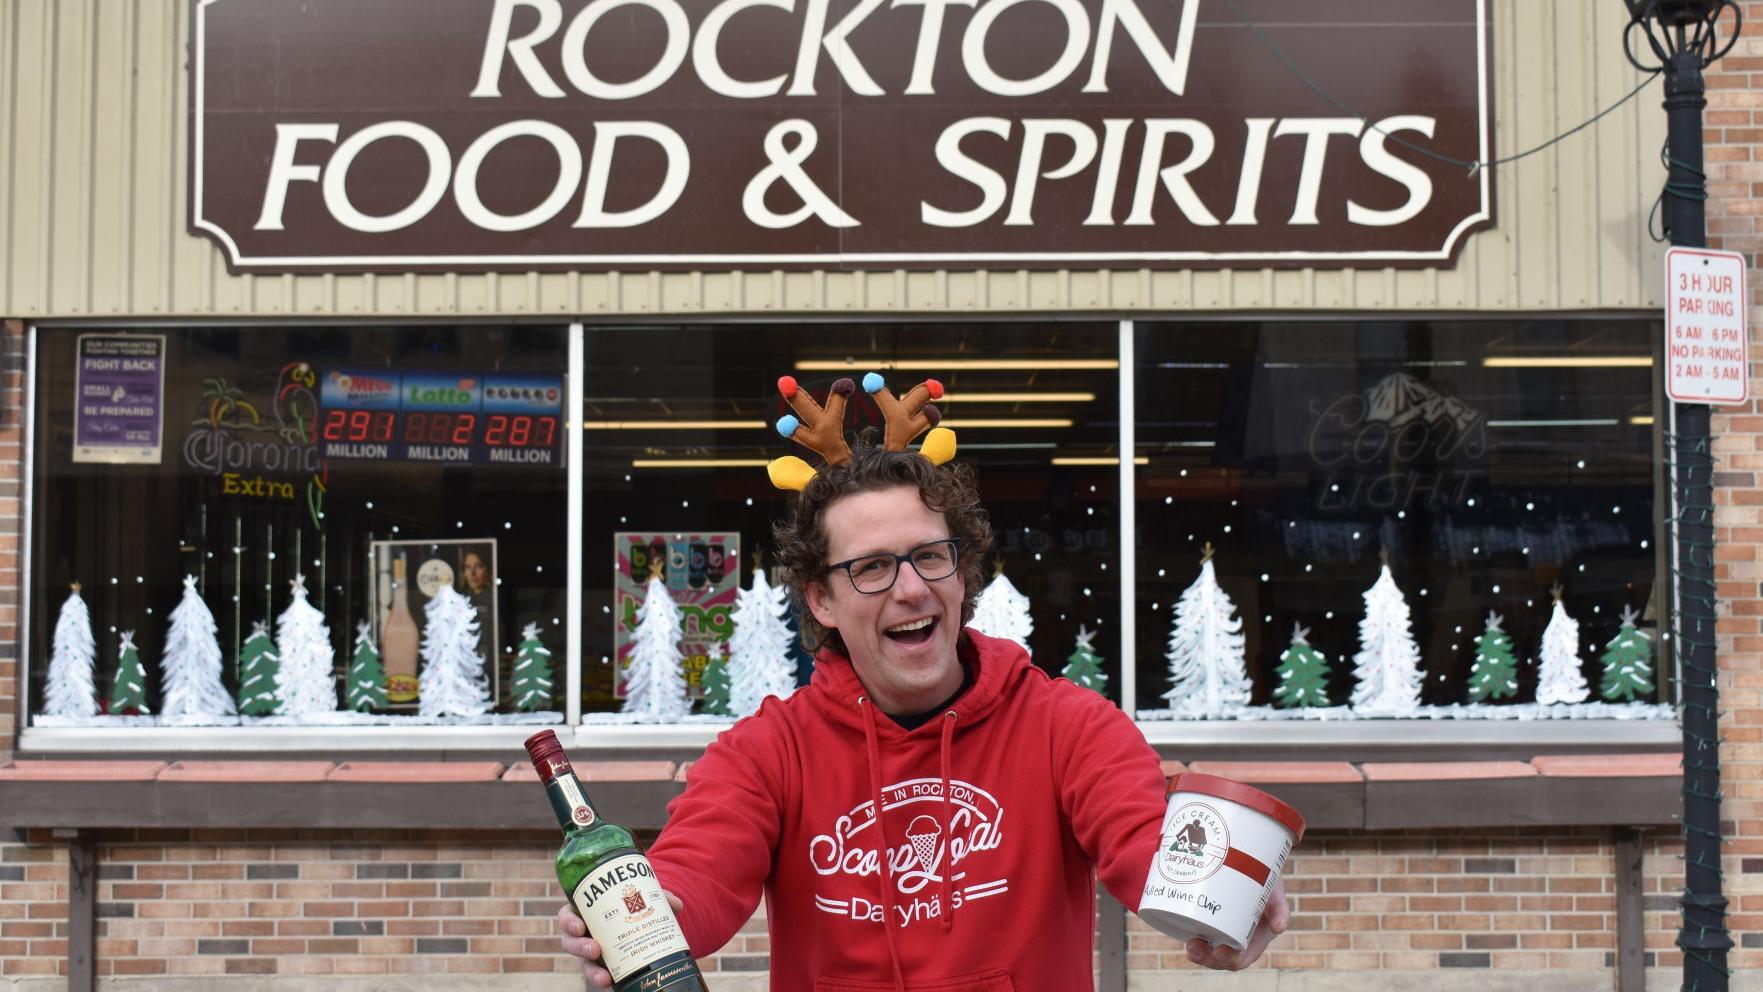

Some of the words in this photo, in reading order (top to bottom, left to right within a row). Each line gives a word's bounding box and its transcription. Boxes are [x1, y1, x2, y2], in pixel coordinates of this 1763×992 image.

[470, 0, 1198, 99] ROCKTON
[253, 119, 691, 232] FOOD
[743, 119, 861, 229] &
[921, 115, 1436, 228] SPIRITS
[1680, 272, 1687, 291] 3
[1675, 327, 1682, 339] 6
[1685, 327, 1702, 340] AM
[1722, 329, 1738, 342] PM
[1672, 345, 1688, 358] NO
[85, 359, 119, 370] FIGHT
[123, 359, 156, 370] BACK
[1676, 364, 1682, 377] 2
[1685, 365, 1702, 378] AM
[1722, 367, 1739, 380] AM
[411, 385, 472, 405] Lotto
[84, 406, 97, 416] BE
[101, 407, 154, 417] PREPARED
[324, 410, 394, 441] 291
[485, 415, 556, 446] 287
[326, 443, 388, 459] MILLION
[407, 446, 469, 461] MILLION
[489, 449, 551, 463] MILLION
[223, 472, 295, 499] Extra
[1318, 470, 1486, 510] LIGHT
[894, 788, 907, 801] IN
[1172, 813, 1187, 828] ICE
[1190, 810, 1221, 837] CREAM
[1165, 852, 1206, 869] Dairyhäus
[583, 862, 656, 908] JAMESON
[1167, 887, 1194, 903] Wine
[1197, 894, 1222, 915] Chip
[641, 915, 670, 931] DISTILLED
[617, 926, 641, 941] TRIPLE
[630, 946, 649, 957] IRISH
[649, 933, 676, 947] WHISKEY
